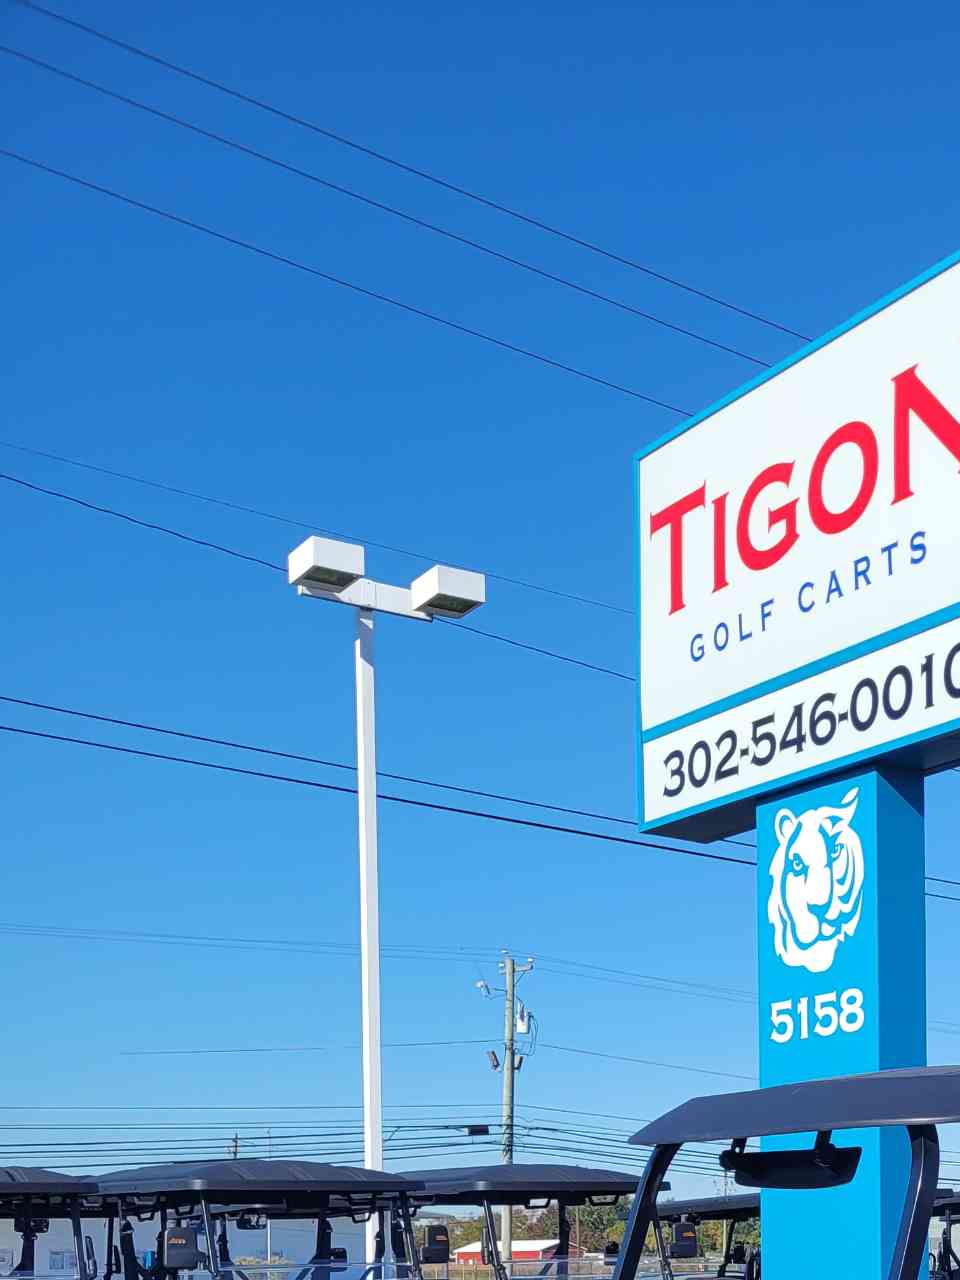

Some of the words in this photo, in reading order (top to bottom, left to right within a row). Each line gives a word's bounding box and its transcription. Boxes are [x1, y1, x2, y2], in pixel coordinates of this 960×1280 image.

[690, 599, 774, 662] GOLF
[800, 530, 928, 613] CARTS
[770, 988, 864, 1043] 5158
